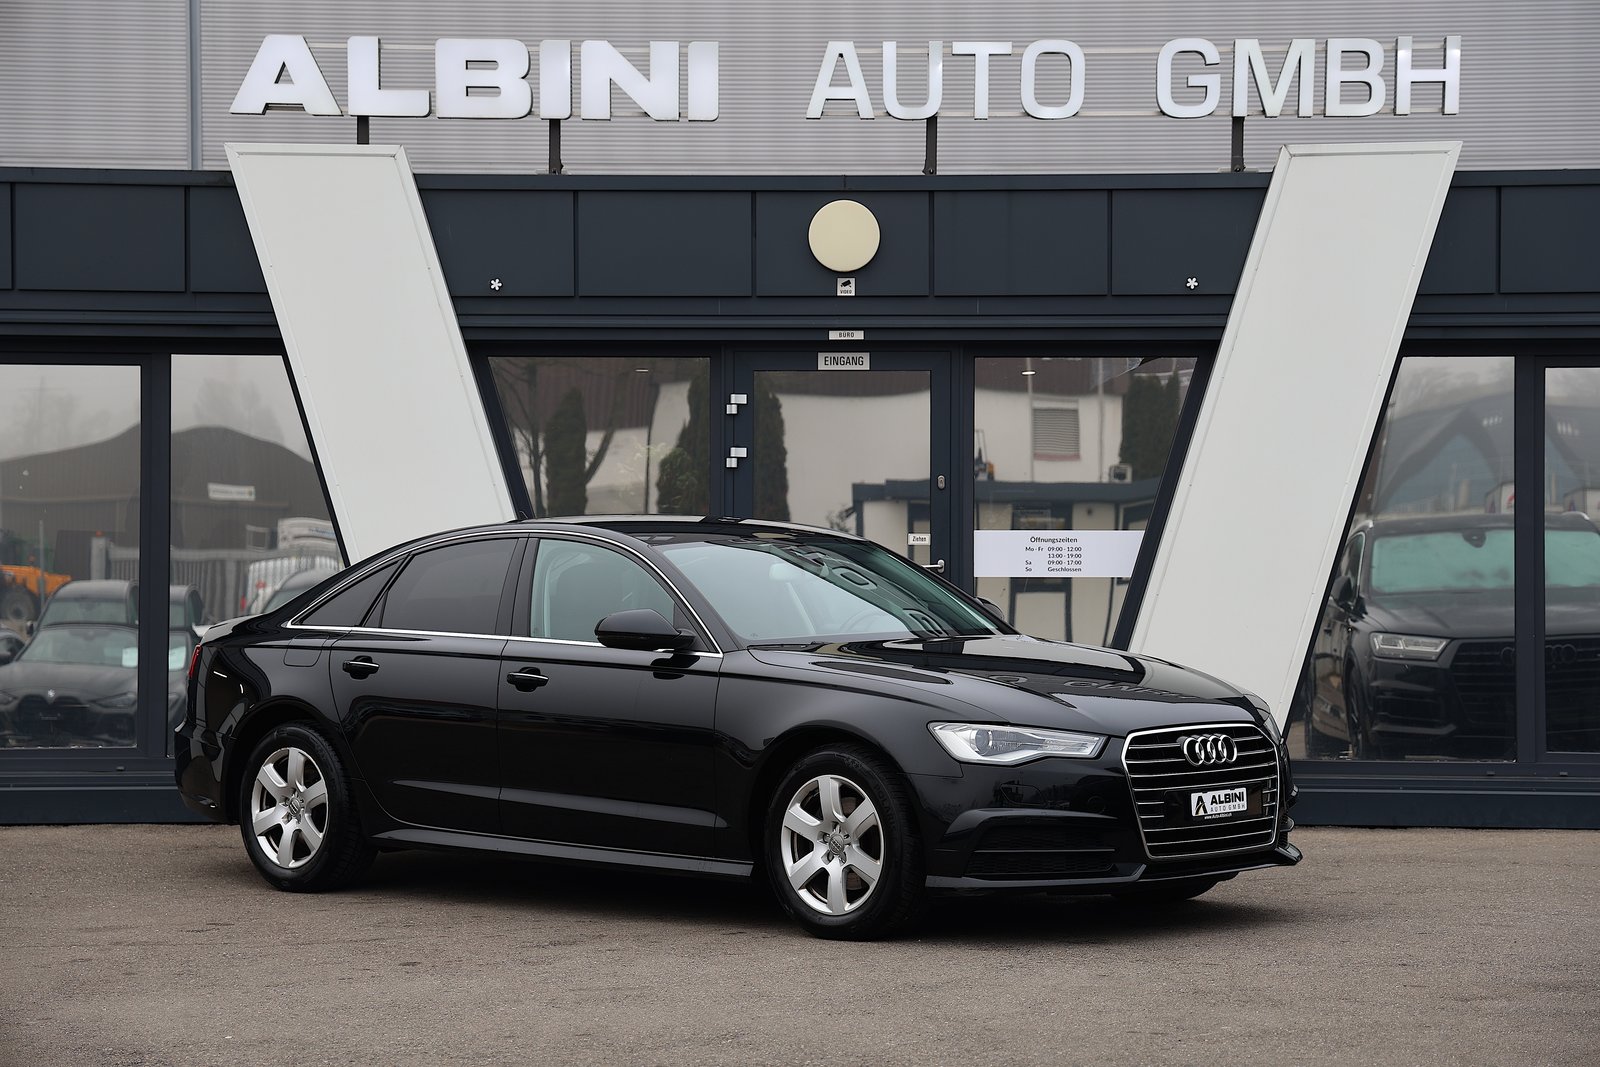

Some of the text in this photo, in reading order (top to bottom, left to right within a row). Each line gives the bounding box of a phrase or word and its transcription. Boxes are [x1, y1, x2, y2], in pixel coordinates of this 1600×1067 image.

[229, 34, 1462, 121] ALBINI AUTO GMBH
[824, 356, 864, 366] EINGANG
[1030, 535, 1078, 544] Öffnungszeiten
[1211, 792, 1244, 805] ALBINI
